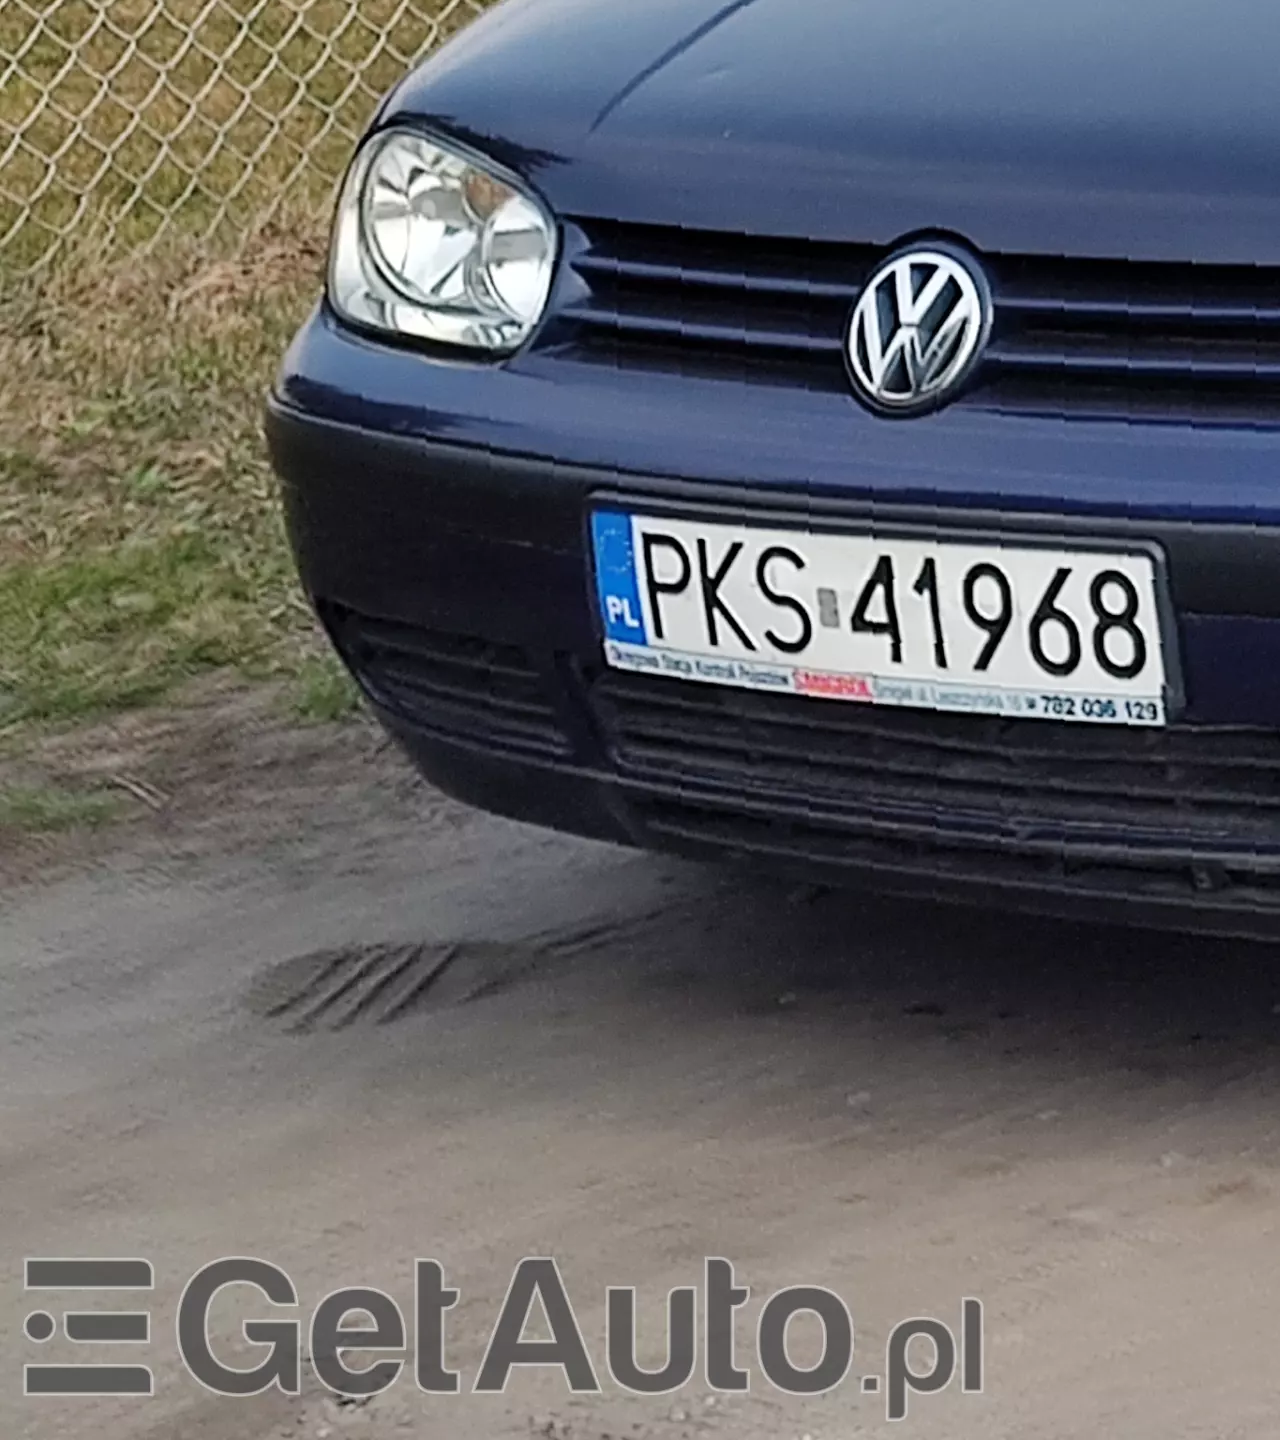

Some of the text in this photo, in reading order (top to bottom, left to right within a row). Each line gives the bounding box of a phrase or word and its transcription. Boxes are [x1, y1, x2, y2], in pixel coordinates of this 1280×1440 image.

[606, 596, 639, 627] PL
[642, 533, 1148, 680] PKS 41968
